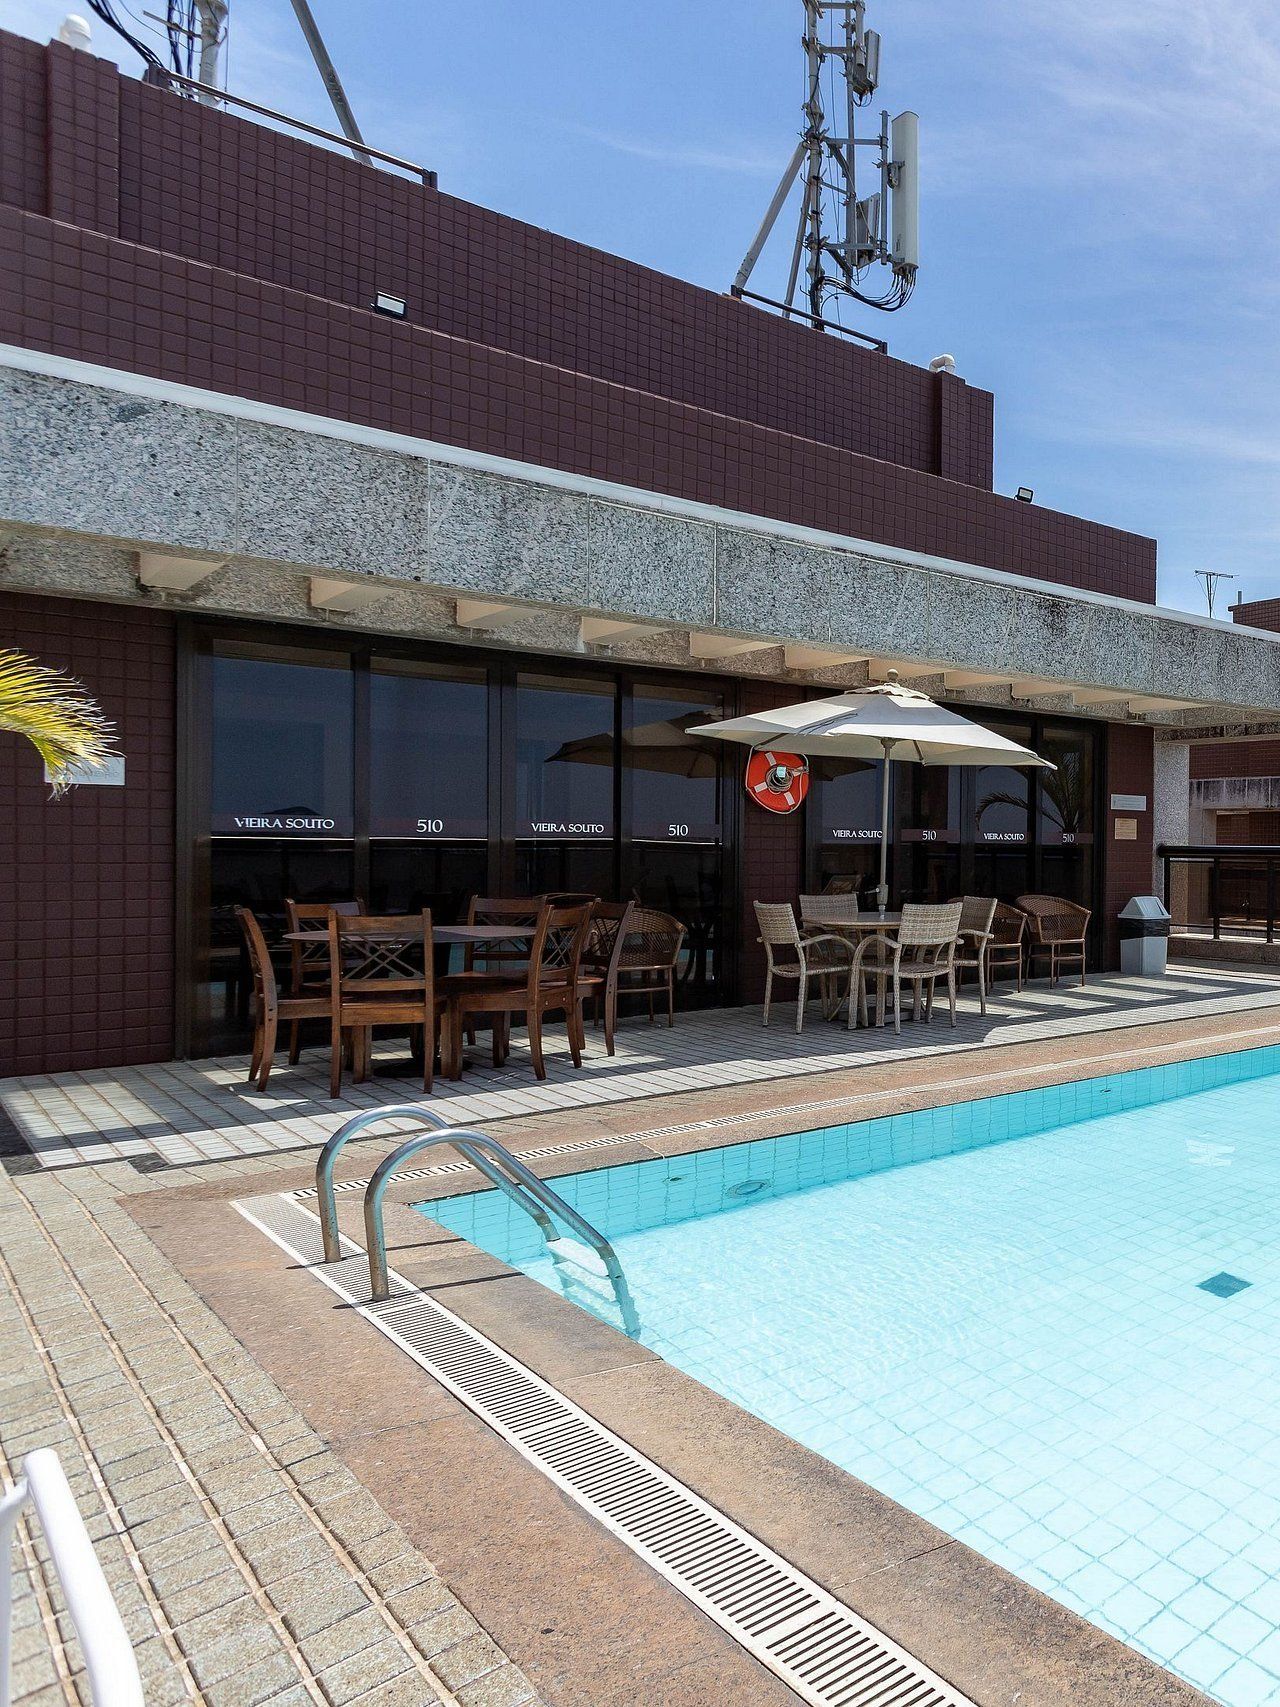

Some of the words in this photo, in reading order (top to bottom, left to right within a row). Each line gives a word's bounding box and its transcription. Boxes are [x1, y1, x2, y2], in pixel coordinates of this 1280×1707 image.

[234, 817, 282, 828] VIEIRA
[285, 818, 334, 829] SOUTO
[416, 819, 443, 832] 510
[531, 823, 566, 832] VIEIRA
[568, 824, 604, 833] SOUTO
[668, 824, 688, 836] 510
[833, 829, 857, 838] VIEIRA
[922, 830, 936, 841] 510
[984, 832, 1003, 840] VIEIRA
[1004, 833, 1025, 841] SOUTO
[1062, 833, 1075, 843] 510
